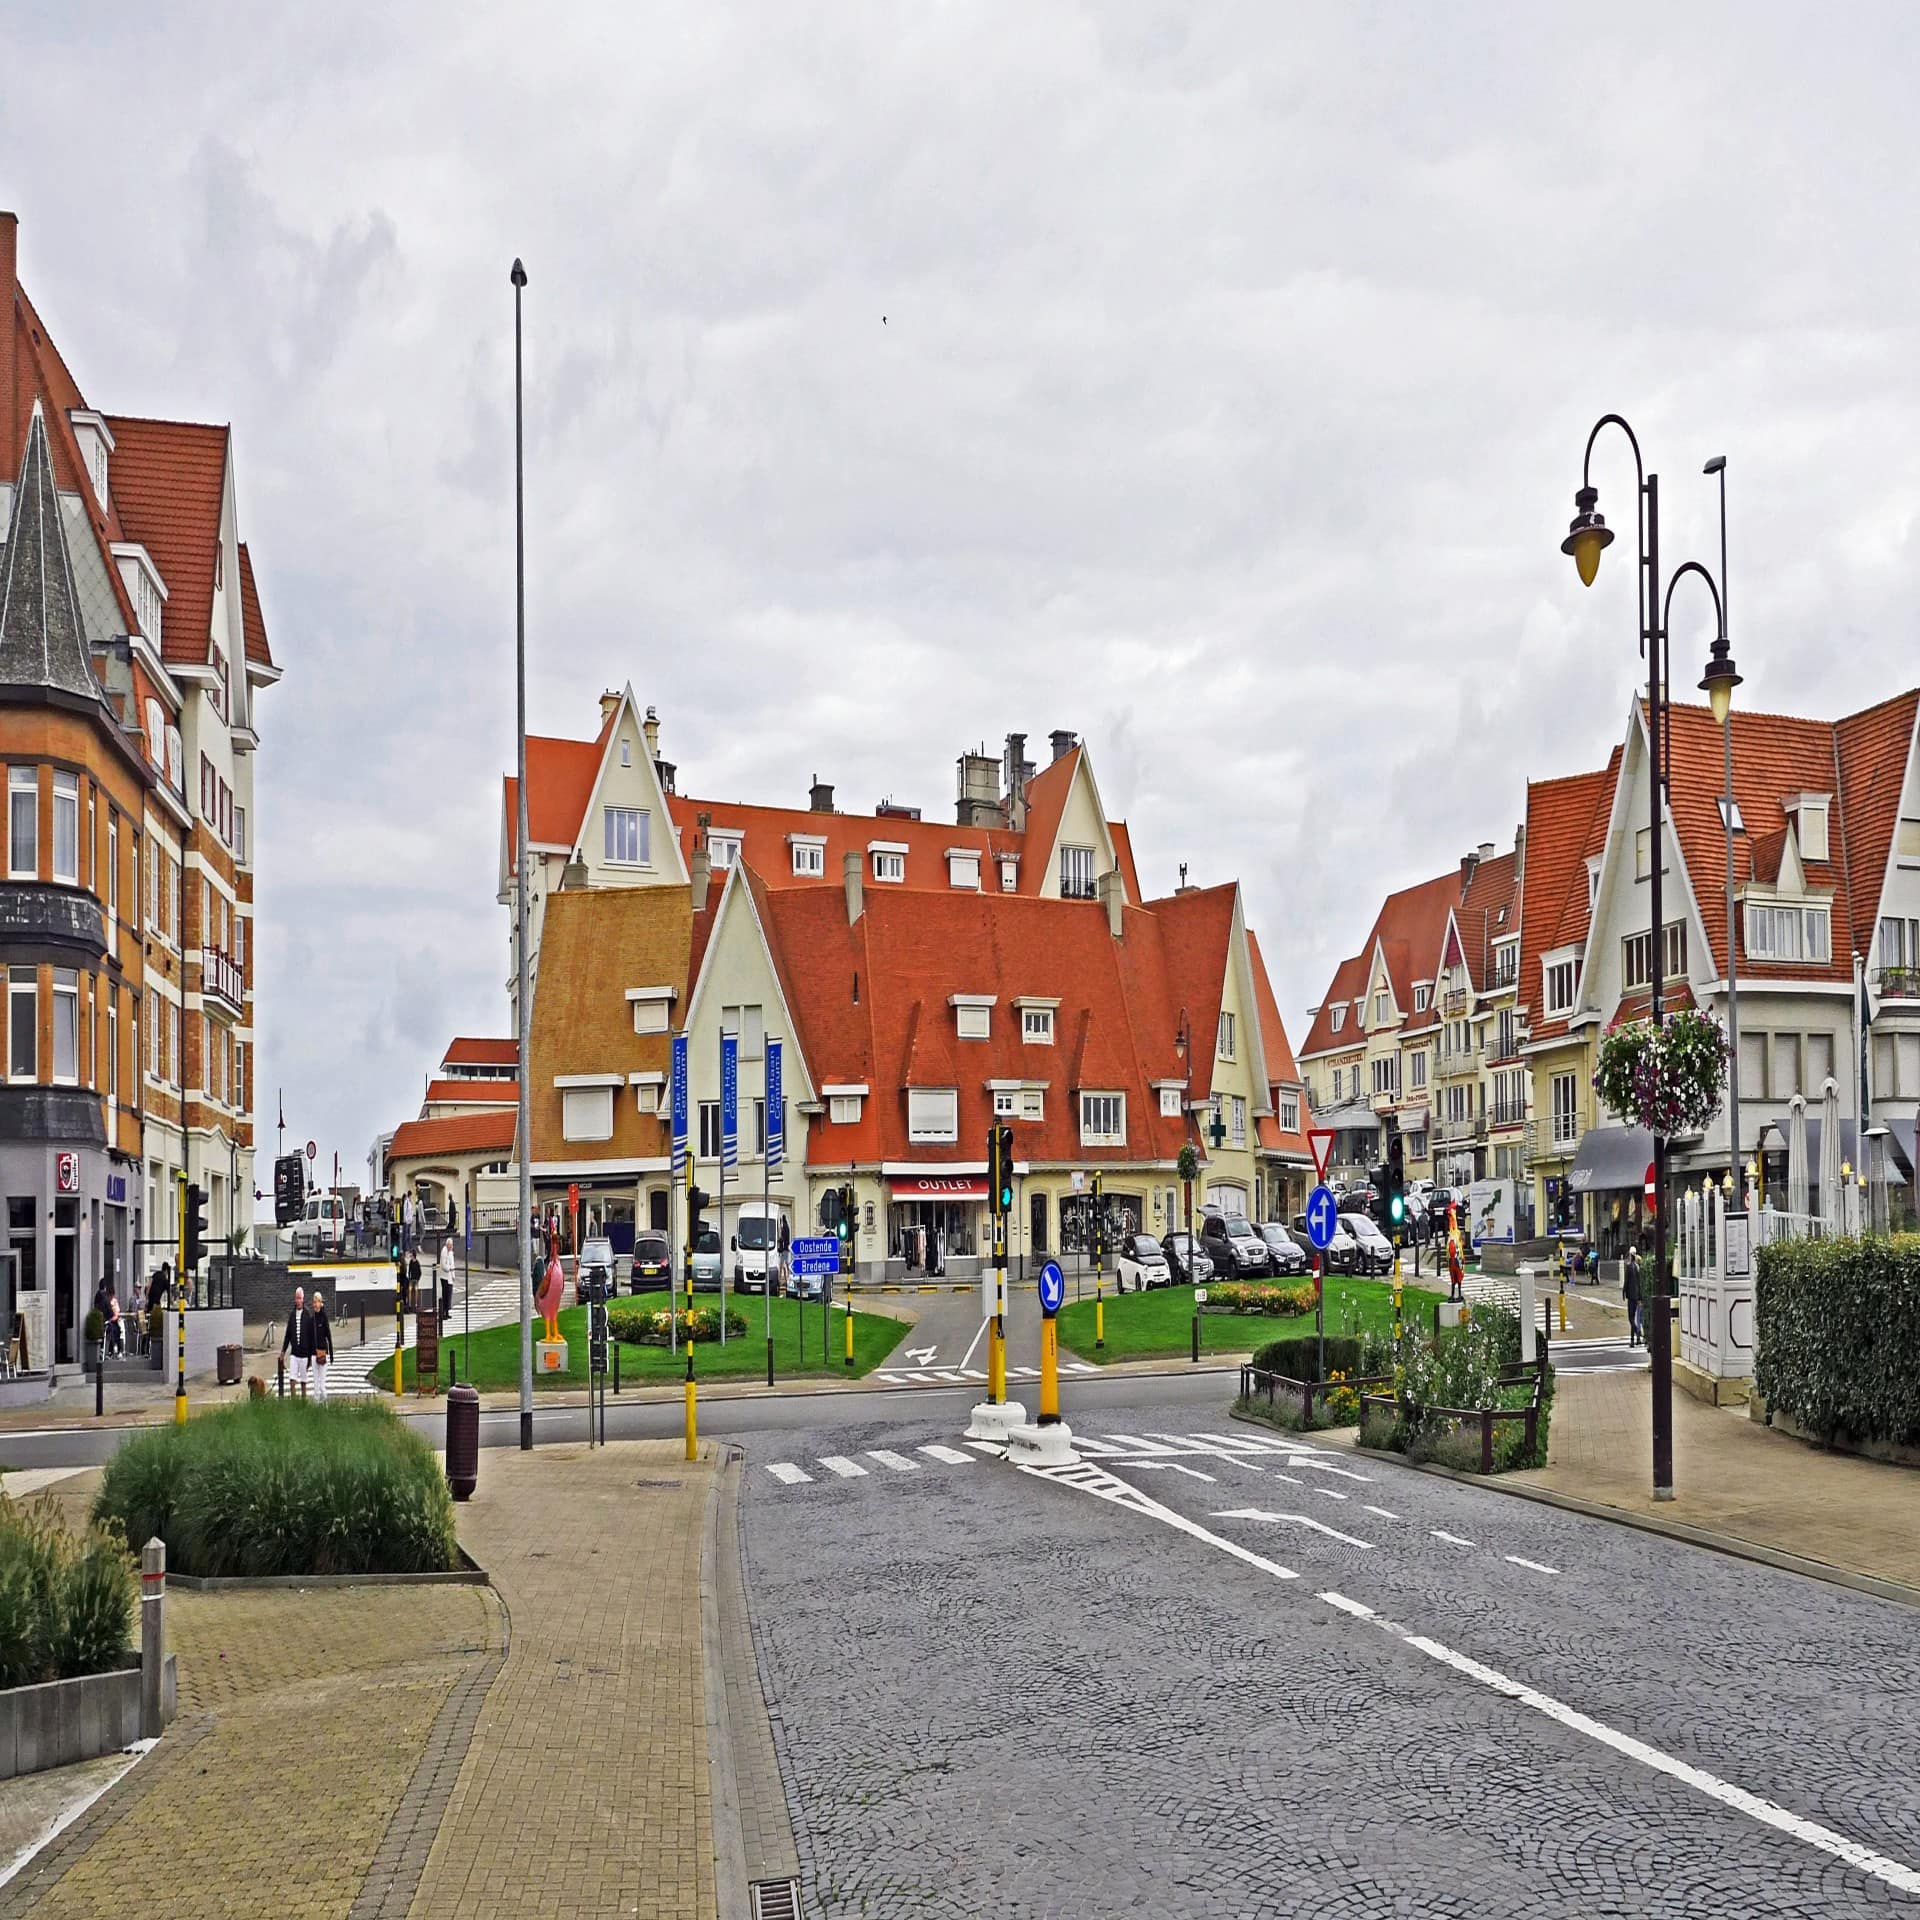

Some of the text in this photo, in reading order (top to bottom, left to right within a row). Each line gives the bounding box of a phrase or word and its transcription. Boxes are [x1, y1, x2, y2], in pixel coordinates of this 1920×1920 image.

[674, 1092, 681, 1113] De
[724, 1092, 731, 1113] De
[768, 1093, 775, 1114] De
[918, 1179, 972, 1191] OUTLET
[800, 1240, 832, 1253] Oostende
[801, 1259, 831, 1273] Bredene
